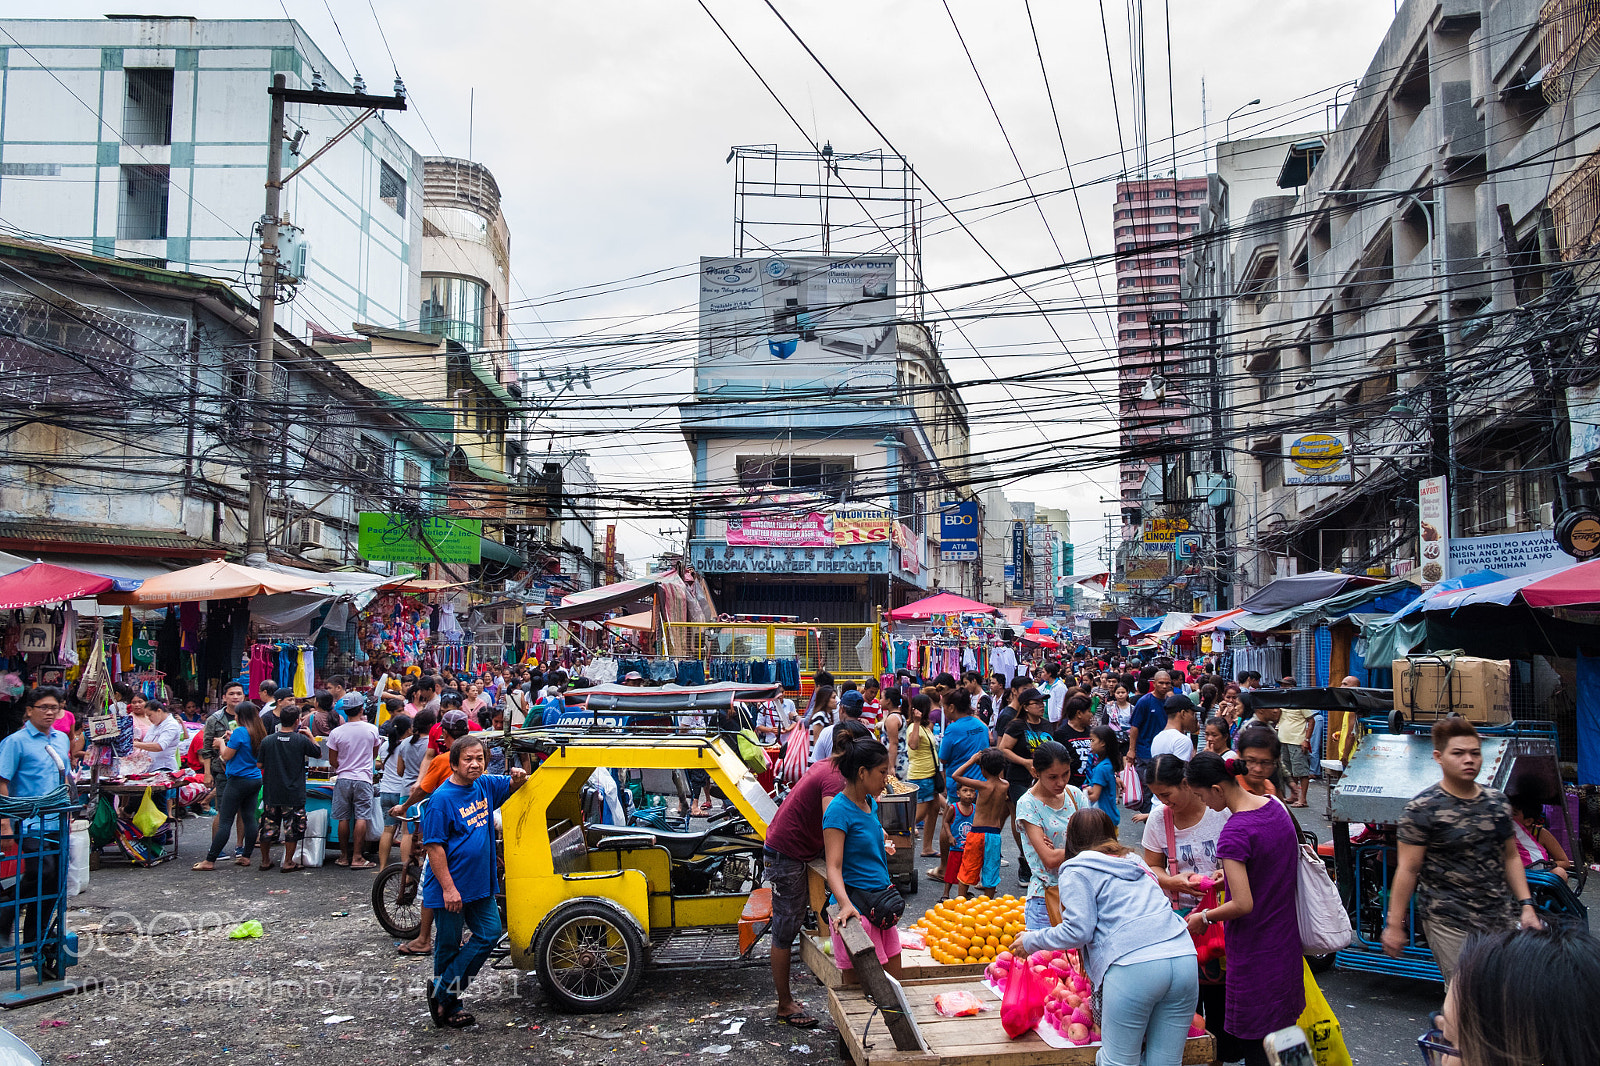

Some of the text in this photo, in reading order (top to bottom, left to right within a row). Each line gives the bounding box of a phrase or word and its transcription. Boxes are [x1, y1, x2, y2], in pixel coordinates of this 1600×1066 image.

[829, 262, 864, 270] HEAVY
[836, 511, 883, 519] VOLUNTEER
[944, 515, 973, 526] BDO
[1449, 544, 1475, 552] KUNG
[1476, 542, 1502, 550] HINDI
[1479, 549, 1498, 557] ANG
[1458, 557, 1492, 566] HUWAG
[1527, 552, 1553, 560] LANG
[697, 560, 883, 571] DIVISORIA VOLUNTEER FIREFIGHTER
[1045, 524, 1053, 606] TRANSWORLD
[1484, 562, 1527, 570] DUMIHAN
[139, 592, 168, 601] Sulong
[1343, 784, 1384, 794] KEEP DISTANCE
